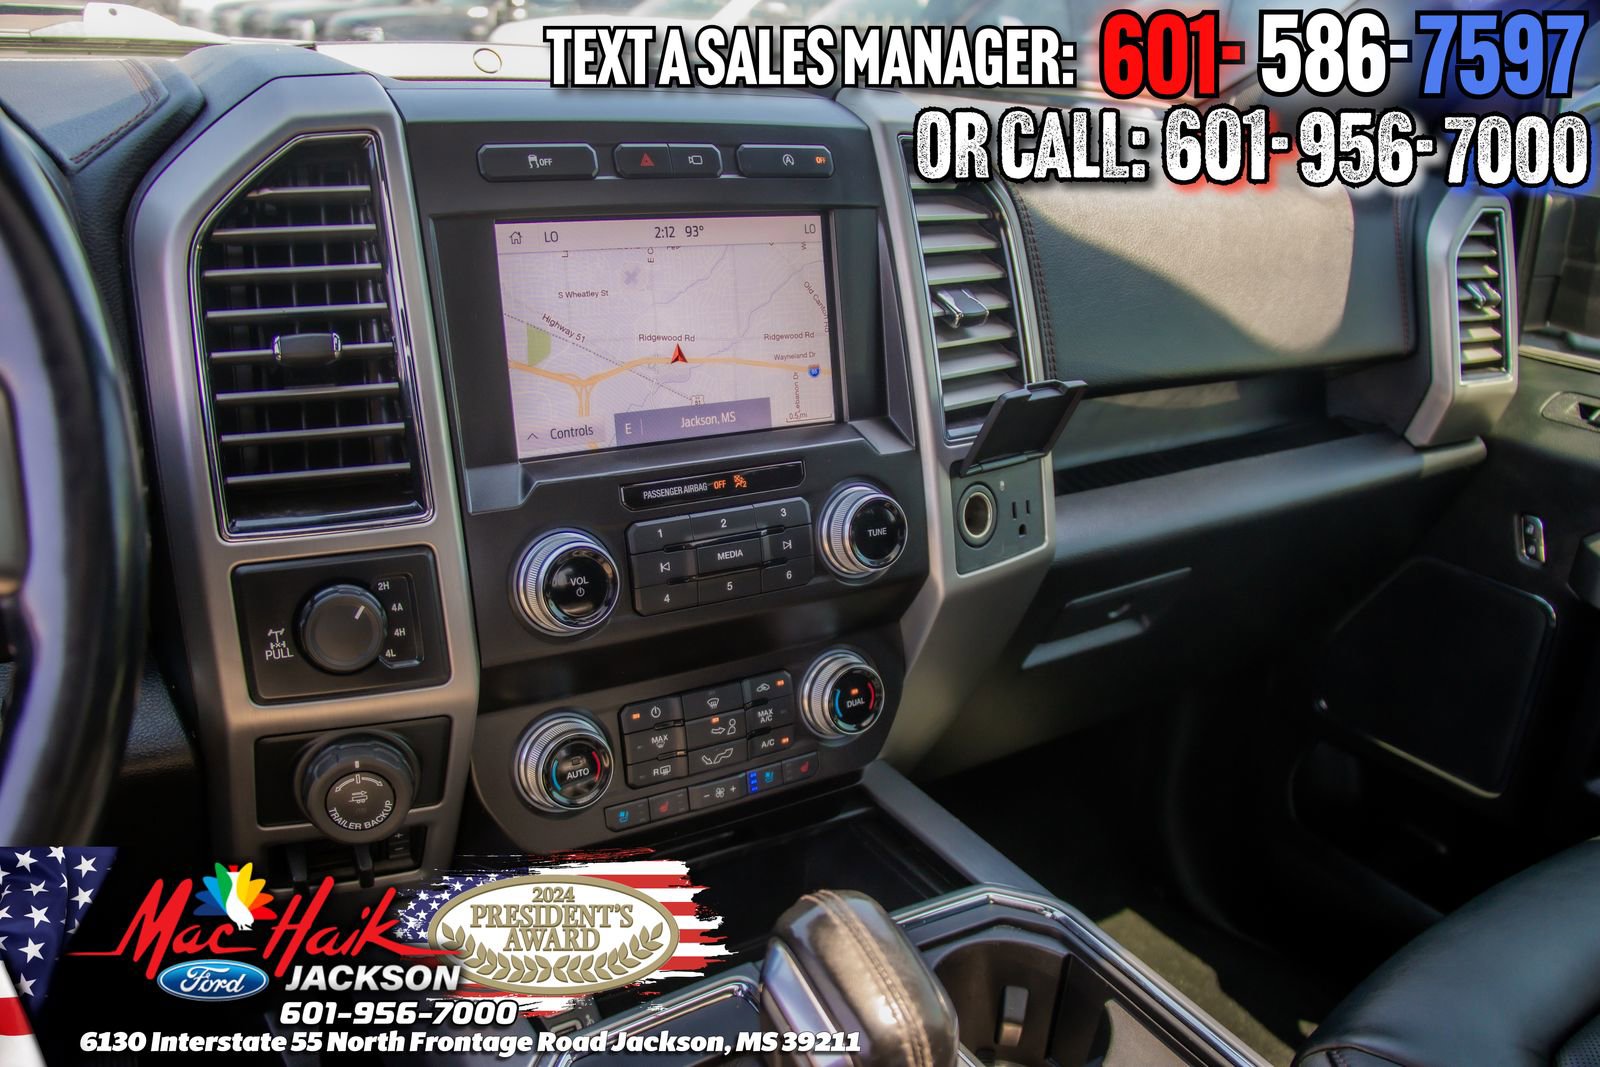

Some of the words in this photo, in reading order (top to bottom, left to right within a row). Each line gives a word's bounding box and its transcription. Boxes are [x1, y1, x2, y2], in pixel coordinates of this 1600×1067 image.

[539, 157, 553, 166] OFF
[654, 225, 676, 239] 2:12
[685, 224, 704, 238] 93°
[804, 223, 817, 235] LO
[544, 230, 559, 243] LO
[803, 281, 814, 295] Old
[558, 291, 564, 299] S
[565, 290, 597, 299] Wheatley
[600, 289, 609, 297] St
[541, 313, 575, 338] Highway
[575, 331, 586, 343] 51
[638, 333, 683, 343] Ridgewood
[684, 333, 696, 342] Rd
[763, 332, 804, 342] Ridgewood
[804, 331, 815, 339] Rd
[773, 352, 808, 362] Wayneland
[808, 351, 817, 359] Dr
[680, 413, 721, 429] Jackson,
[721, 411, 736, 425] MS
[550, 424, 594, 440] Controls
[625, 422, 633, 435] E
[642, 486, 683, 500] PASSENGER
[683, 482, 708, 495] AIRBAG
[713, 479, 727, 490] OFF
[780, 507, 787, 517] 3
[719, 518, 728, 528] 2
[657, 528, 663, 539] 1
[867, 527, 887, 537] TUNE
[717, 549, 744, 561] MEDIA
[569, 575, 589, 586] VOL
[785, 570, 792, 580] 6
[377, 581, 390, 591] 2H
[726, 581, 733, 591] 5
[663, 593, 670, 604] 4
[391, 602, 404, 612] 4A
[393, 627, 406, 637] 4H
[265, 647, 294, 660] PULL
[385, 648, 397, 658] 4L
[846, 698, 866, 709] DUAL
[757, 708, 774, 718] MAX
[760, 715, 773, 724] A/C
[651, 734, 669, 744] MAX
[761, 739, 776, 749] A/C
[566, 767, 590, 780] AUTO
[328, 807, 362, 830] TRAILER
[363, 800, 393, 830] BACKUP
